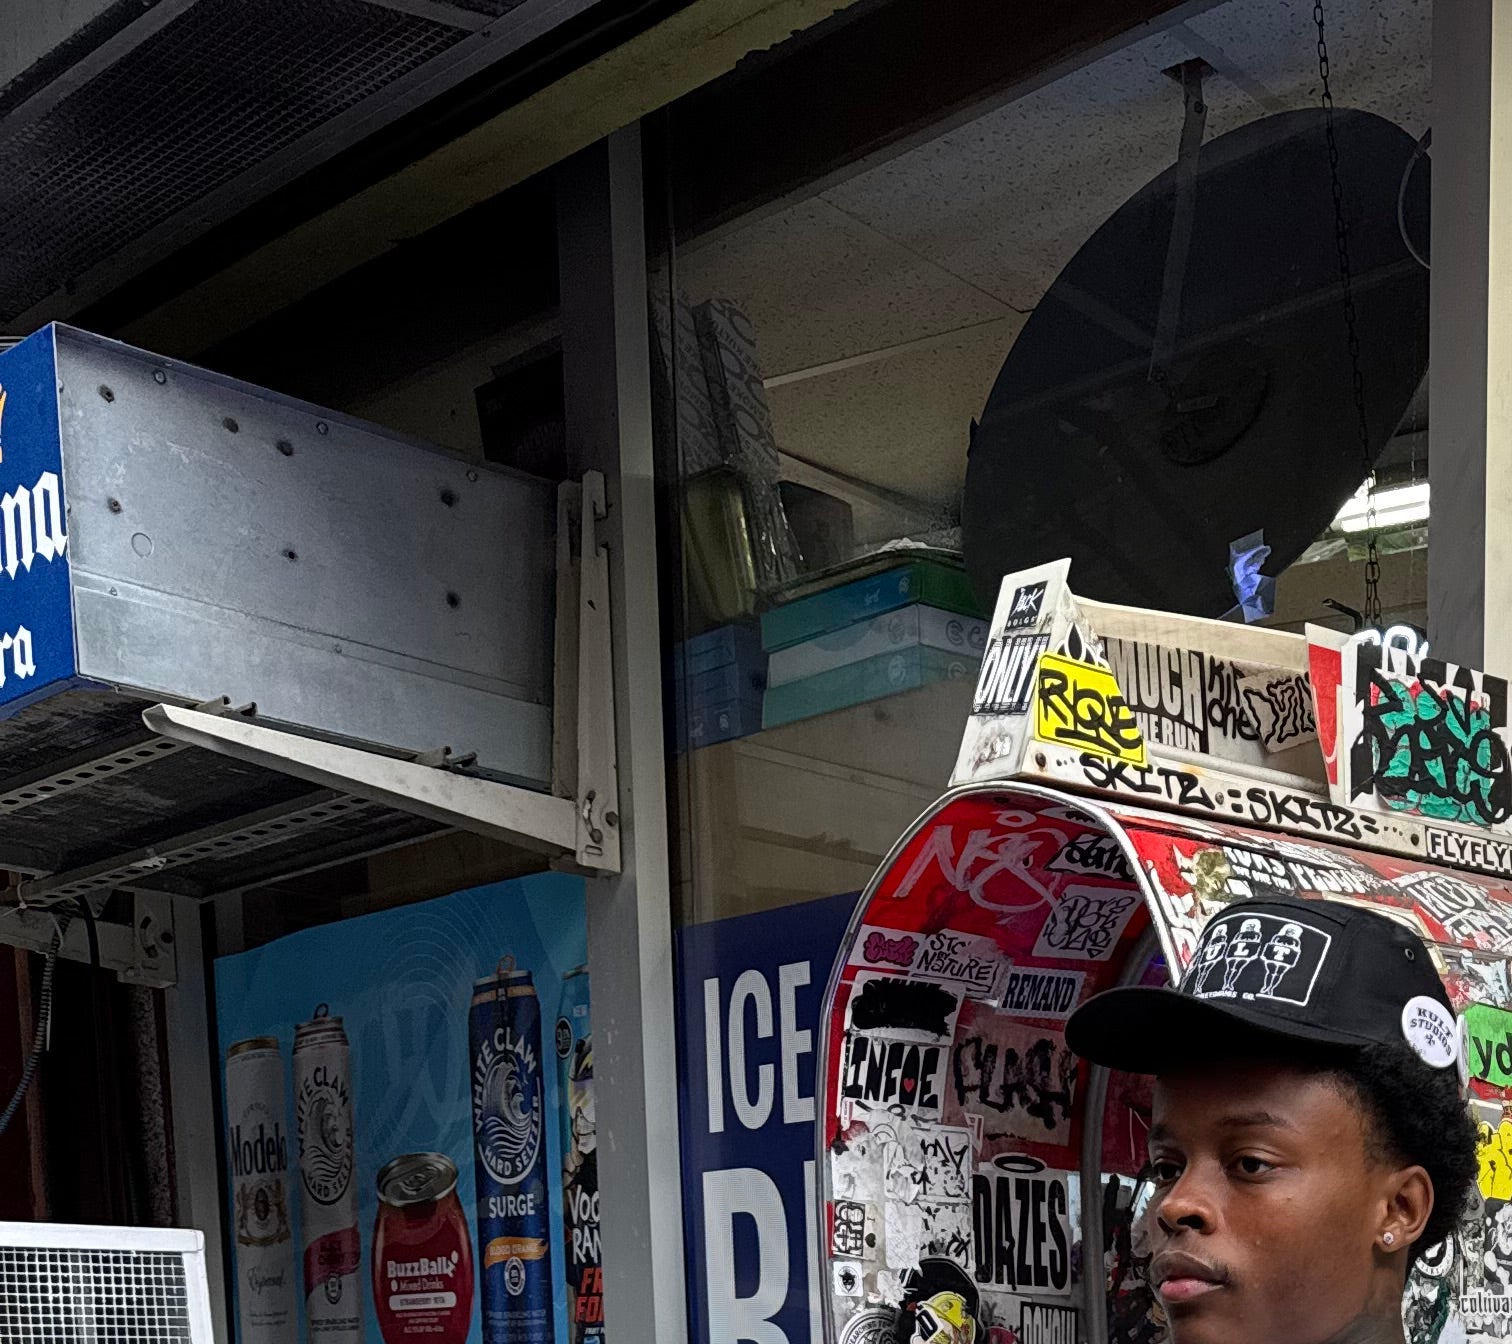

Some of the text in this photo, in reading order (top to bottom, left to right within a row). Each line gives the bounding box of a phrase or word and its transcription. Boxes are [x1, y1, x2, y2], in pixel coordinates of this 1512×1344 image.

[0, 471, 68, 580] na
[1161, 718, 1200, 752] RUN
[1002, 972, 1076, 1013] REMAND
[1410, 1017, 1452, 1057] STUDIOS
[1416, 1006, 1454, 1038] KULT
[493, 1026, 538, 1074] CLAW
[704, 961, 815, 1133] ICE
[489, 1194, 535, 1219] SURGE
[973, 1173, 1069, 1291] DAZES
